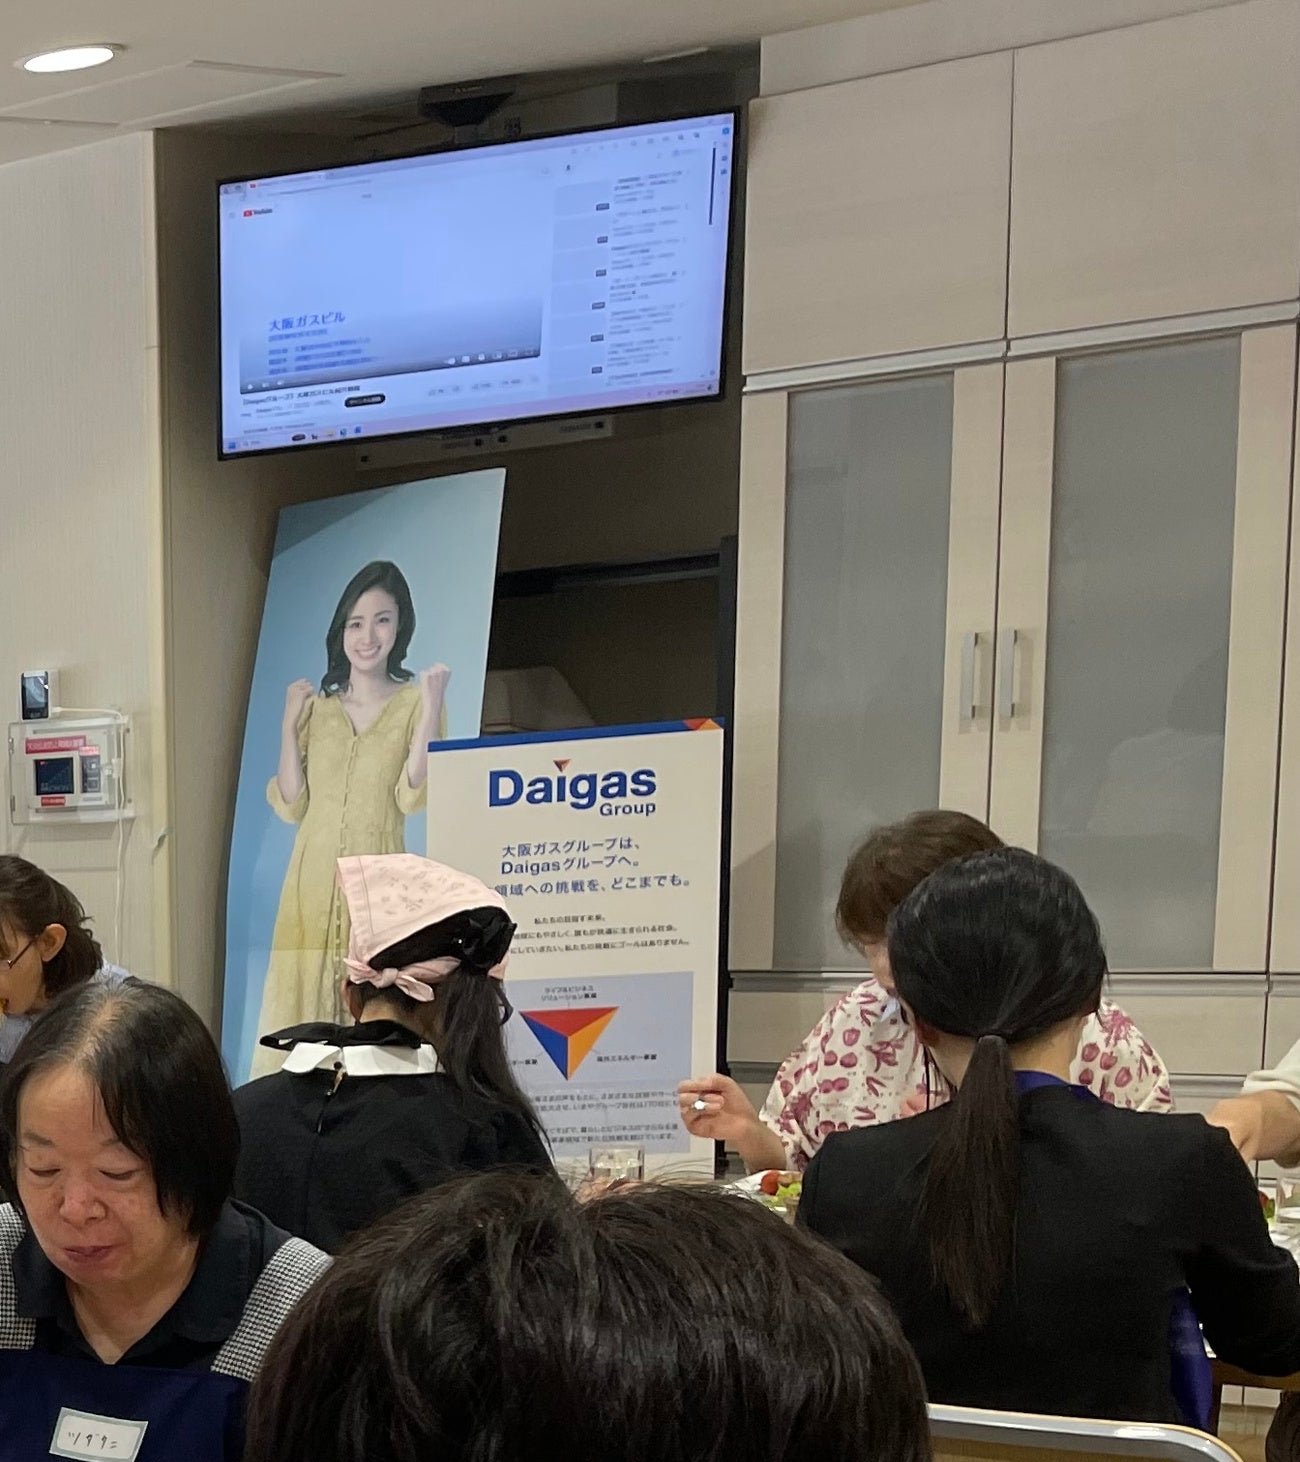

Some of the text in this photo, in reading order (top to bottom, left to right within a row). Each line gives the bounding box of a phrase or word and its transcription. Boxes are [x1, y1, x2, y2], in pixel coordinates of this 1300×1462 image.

[269, 312, 346, 332] 大阪ガスビル
[489, 761, 657, 809] Daigas
[600, 802, 657, 817] Group
[502, 837, 640, 858] 大阪ガスグループは、
[501, 854, 640, 876] Daigasグループへ。
